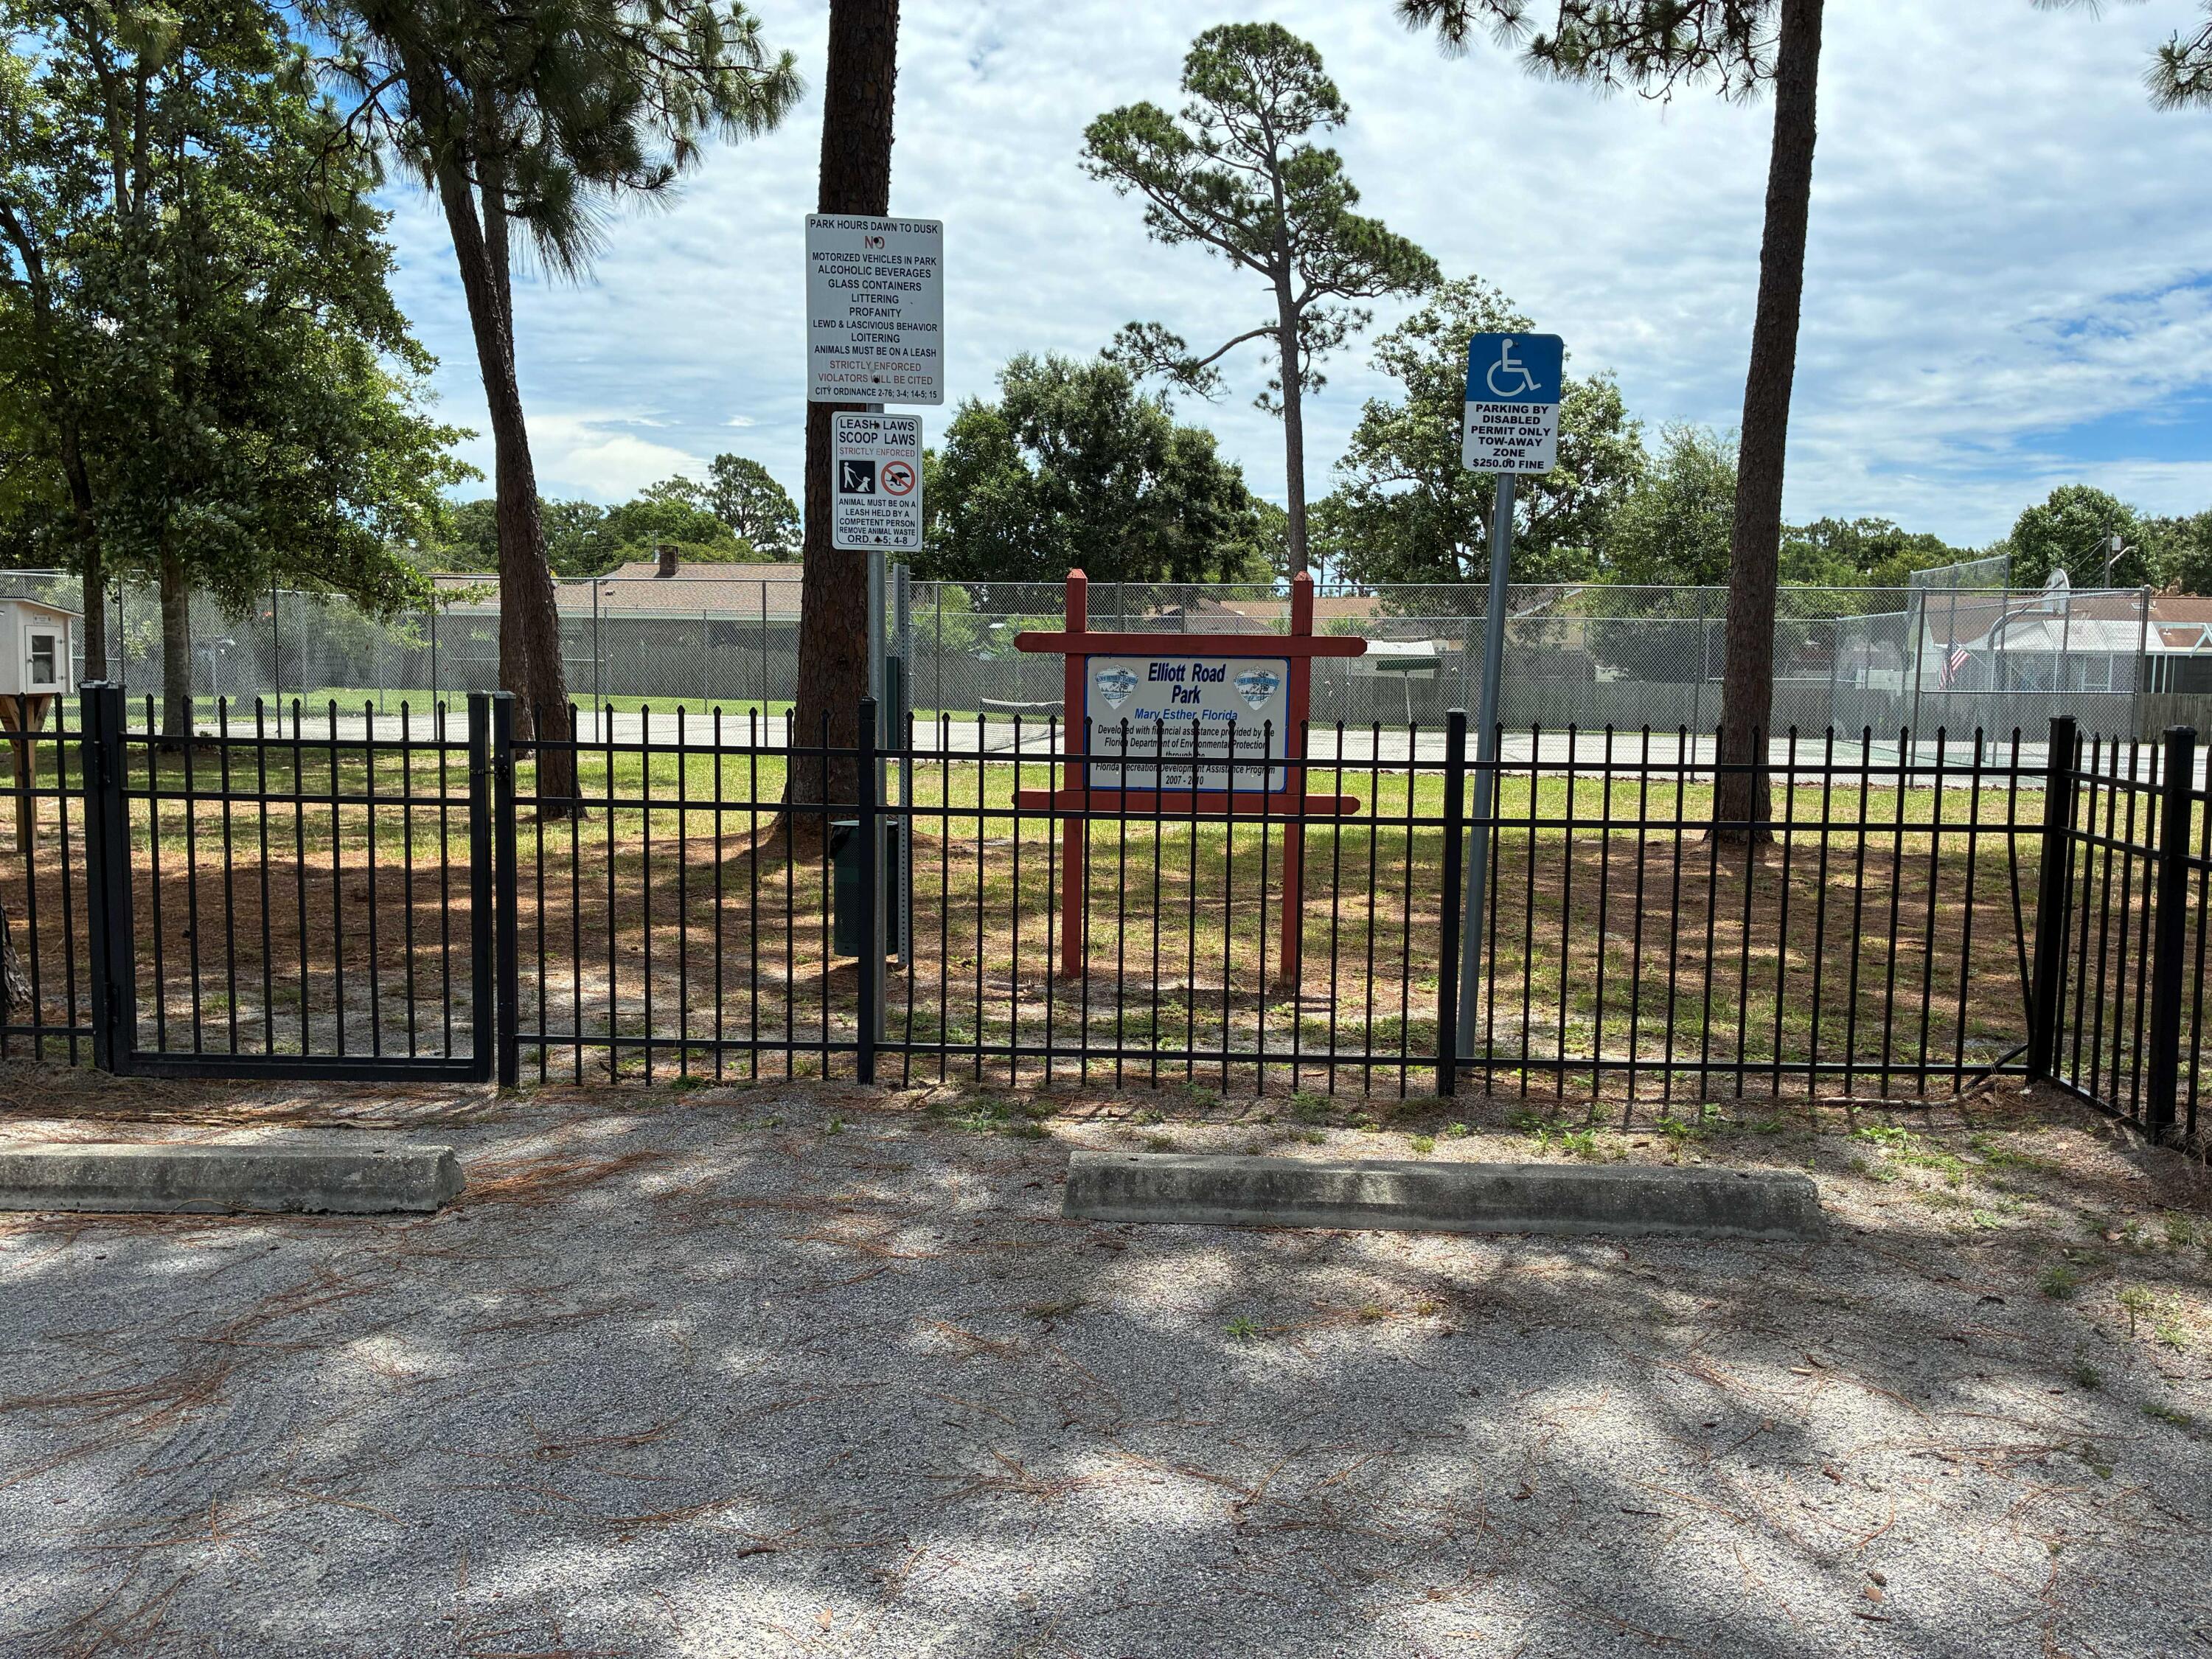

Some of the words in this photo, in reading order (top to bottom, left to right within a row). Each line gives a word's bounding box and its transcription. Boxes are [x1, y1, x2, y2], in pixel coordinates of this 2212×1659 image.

[810, 219, 835, 229] PARK
[838, 220, 869, 230] HOURS
[871, 222, 897, 232] DAWN
[900, 223, 911, 232] TO
[914, 224, 938, 234] DUSK
[865, 236, 885, 249] NO
[813, 252, 860, 262] MOTORIZED
[863, 254, 902, 264] VEHICLES
[905, 256, 912, 265] IN
[914, 257, 937, 265] PARK
[818, 265, 872, 276] ALCOHOLIC
[875, 268, 931, 278] BEVERAGES
[828, 279, 859, 288] GLASS
[863, 280, 922, 291] CONTAINERS
[852, 293, 899, 304] LITTERING
[849, 307, 902, 318] PROFANITY
[813, 320, 836, 328] LEWD
[846, 321, 894, 330] LASCIVIOUS
[897, 323, 938, 332] BEHAVIOR
[852, 333, 900, 343] LOITERING
[815, 345, 850, 355] ANIMALS
[852, 347, 874, 355] MUST
[877, 347, 887, 355] BE
[889, 347, 900, 356] ON
[902, 348, 908, 356] A
[911, 349, 936, 358] LEASH
[830, 361, 872, 369] STRICTLY
[874, 362, 921, 372] ENFORCED
[818, 373, 868, 383] VIOLATORS
[894, 376, 905, 384] BE
[908, 376, 933, 385] CITED
[815, 387, 832, 395] CITY
[834, 388, 876, 397] ORDINANCE
[879, 389, 894, 397] 2-76;
[897, 390, 909, 398] 3-4;
[911, 390, 927, 399] 14-5;
[1476, 404, 1529, 414] PARKING
[1532, 406, 1548, 414] BY
[841, 420, 877, 429] LEASH
[883, 421, 914, 431] LAWS
[1483, 415, 1540, 425] DISABLED
[1471, 426, 1515, 435] PERMIT
[1519, 428, 1551, 437] ONLY
[839, 432, 877, 444] SCOOP
[885, 434, 915, 445] LAWS
[1478, 437, 1543, 447] TOW-AWAY
[840, 448, 874, 456] STRICTLY
[876, 448, 915, 457] ENFORCED
[1493, 448, 1526, 457] ZONE
[1473, 459, 1515, 468] $250.00
[1519, 461, 1544, 469] FINE
[840, 518, 884, 526] COMPETENT
[848, 535, 872, 543] ORD.
[874, 536, 891, 546] -5;
[1148, 663, 1186, 682] Elliott
[1192, 664, 1226, 682] Road
[1172, 685, 1201, 703] Park
[1135, 709, 1161, 722] Mary
[1202, 709, 1238, 720] Florida
[1098, 725, 1134, 734] Develoed
[1136, 726, 1150, 735] with
[1152, 726, 1181, 735] fiancial
[1183, 728, 1219, 736] assstance
[1220, 728, 1251, 738] prvided
[1253, 728, 1262, 739] by
[1130, 738, 1169, 749] Departmnt
[1172, 739, 1179, 748] of
[1180, 739, 1229, 748] Envonmental
[1122, 764, 1158, 772] ecreation
[1206, 765, 1244, 773] Assistnce
[1246, 766, 1275, 776] Progrm
[1166, 776, 1181, 785] 2007
